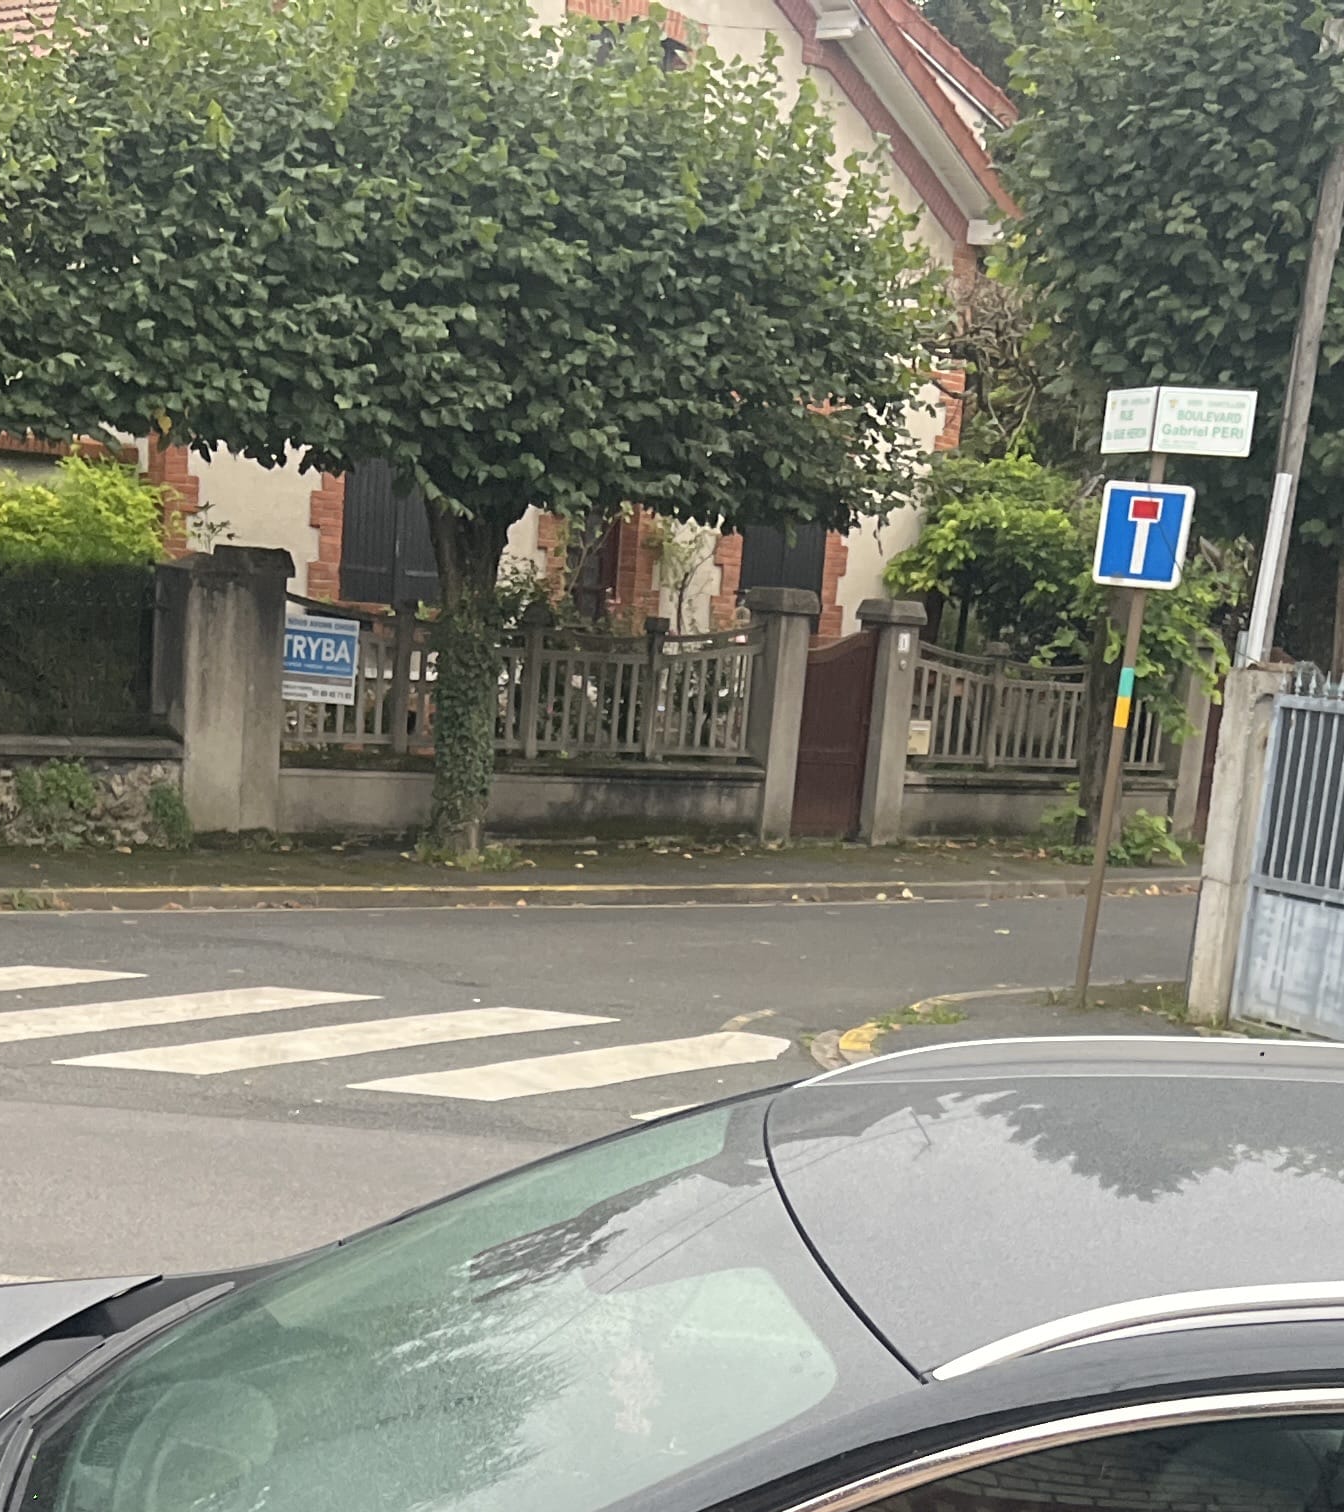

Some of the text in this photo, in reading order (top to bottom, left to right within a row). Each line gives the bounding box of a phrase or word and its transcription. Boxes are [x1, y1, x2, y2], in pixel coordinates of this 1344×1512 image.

[1177, 409, 1242, 424] BOULEVARD
[1162, 423, 1209, 438] Gabriel
[1212, 426, 1244, 440] PERI
[283, 634, 352, 664] TRYBA
